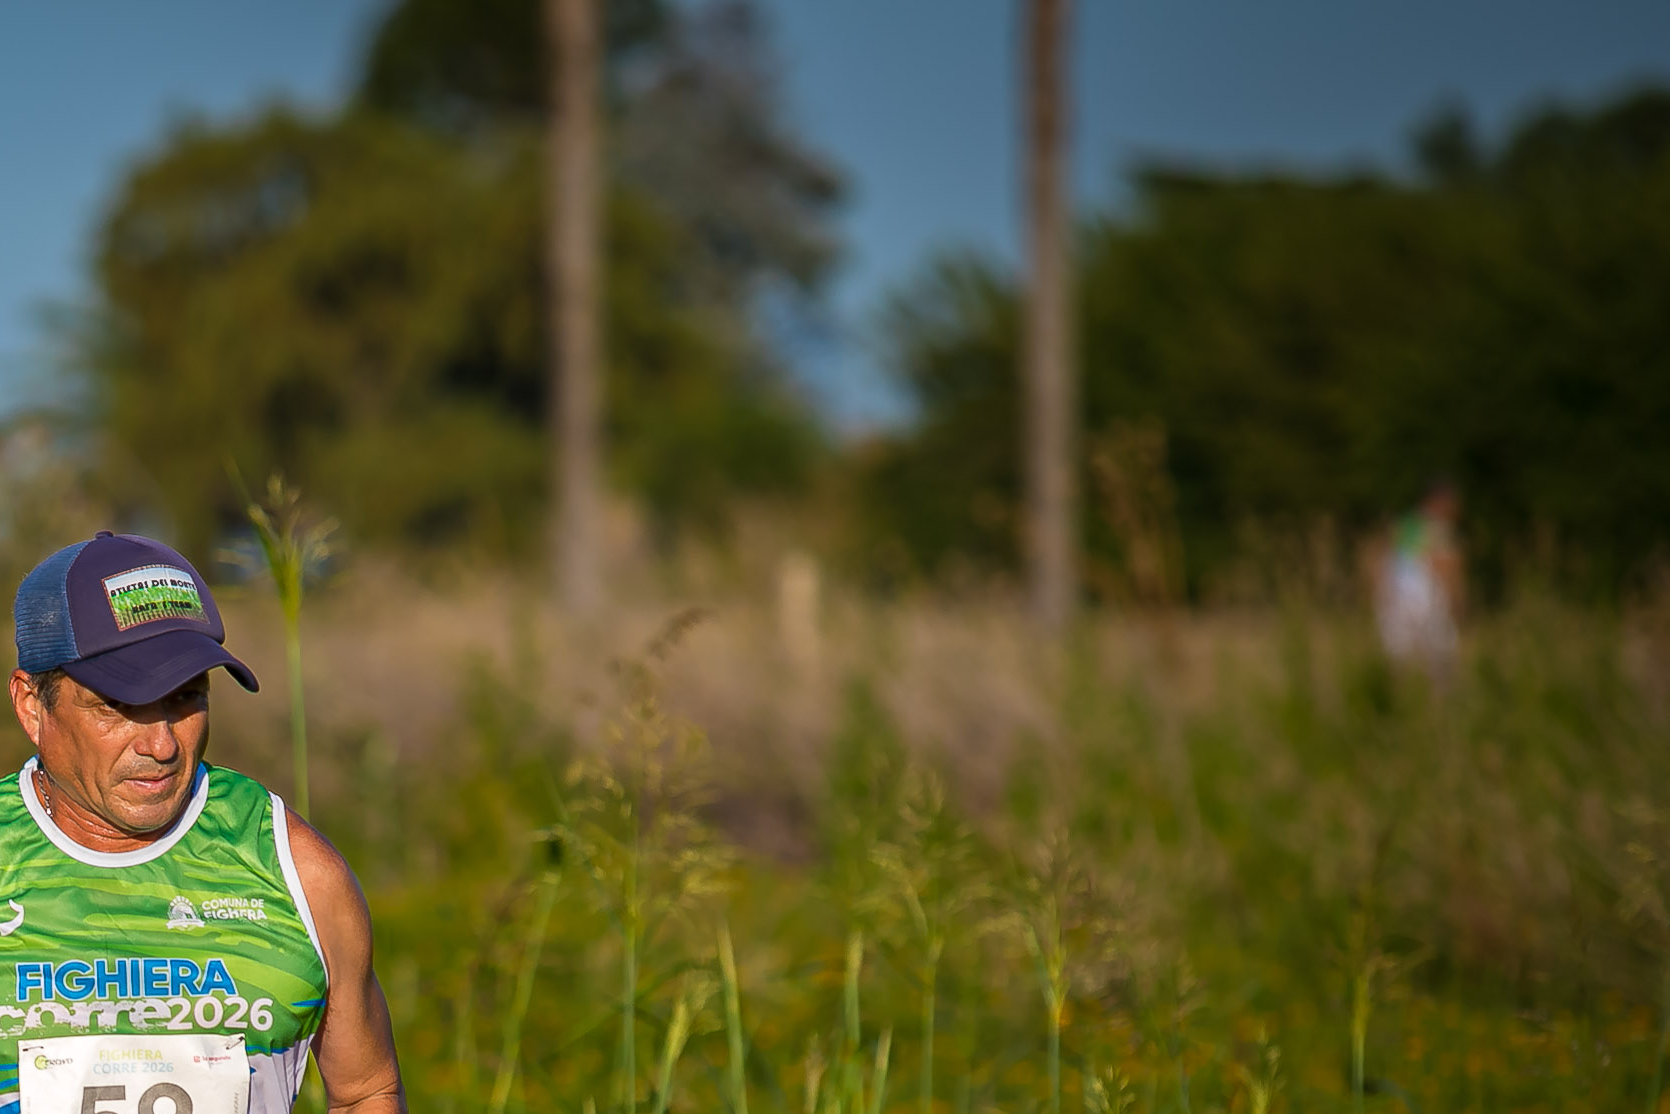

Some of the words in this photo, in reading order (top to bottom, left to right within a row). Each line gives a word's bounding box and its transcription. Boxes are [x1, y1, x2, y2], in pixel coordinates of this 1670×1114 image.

[201, 898, 249, 910] COMUNA
[250, 898, 264, 908] DE
[16, 958, 238, 1002] FIGHIERA
[99, 1049, 163, 1061] FIGHIERA
[93, 1063, 137, 1074] CORRE
[142, 1062, 174, 1073] 2026
